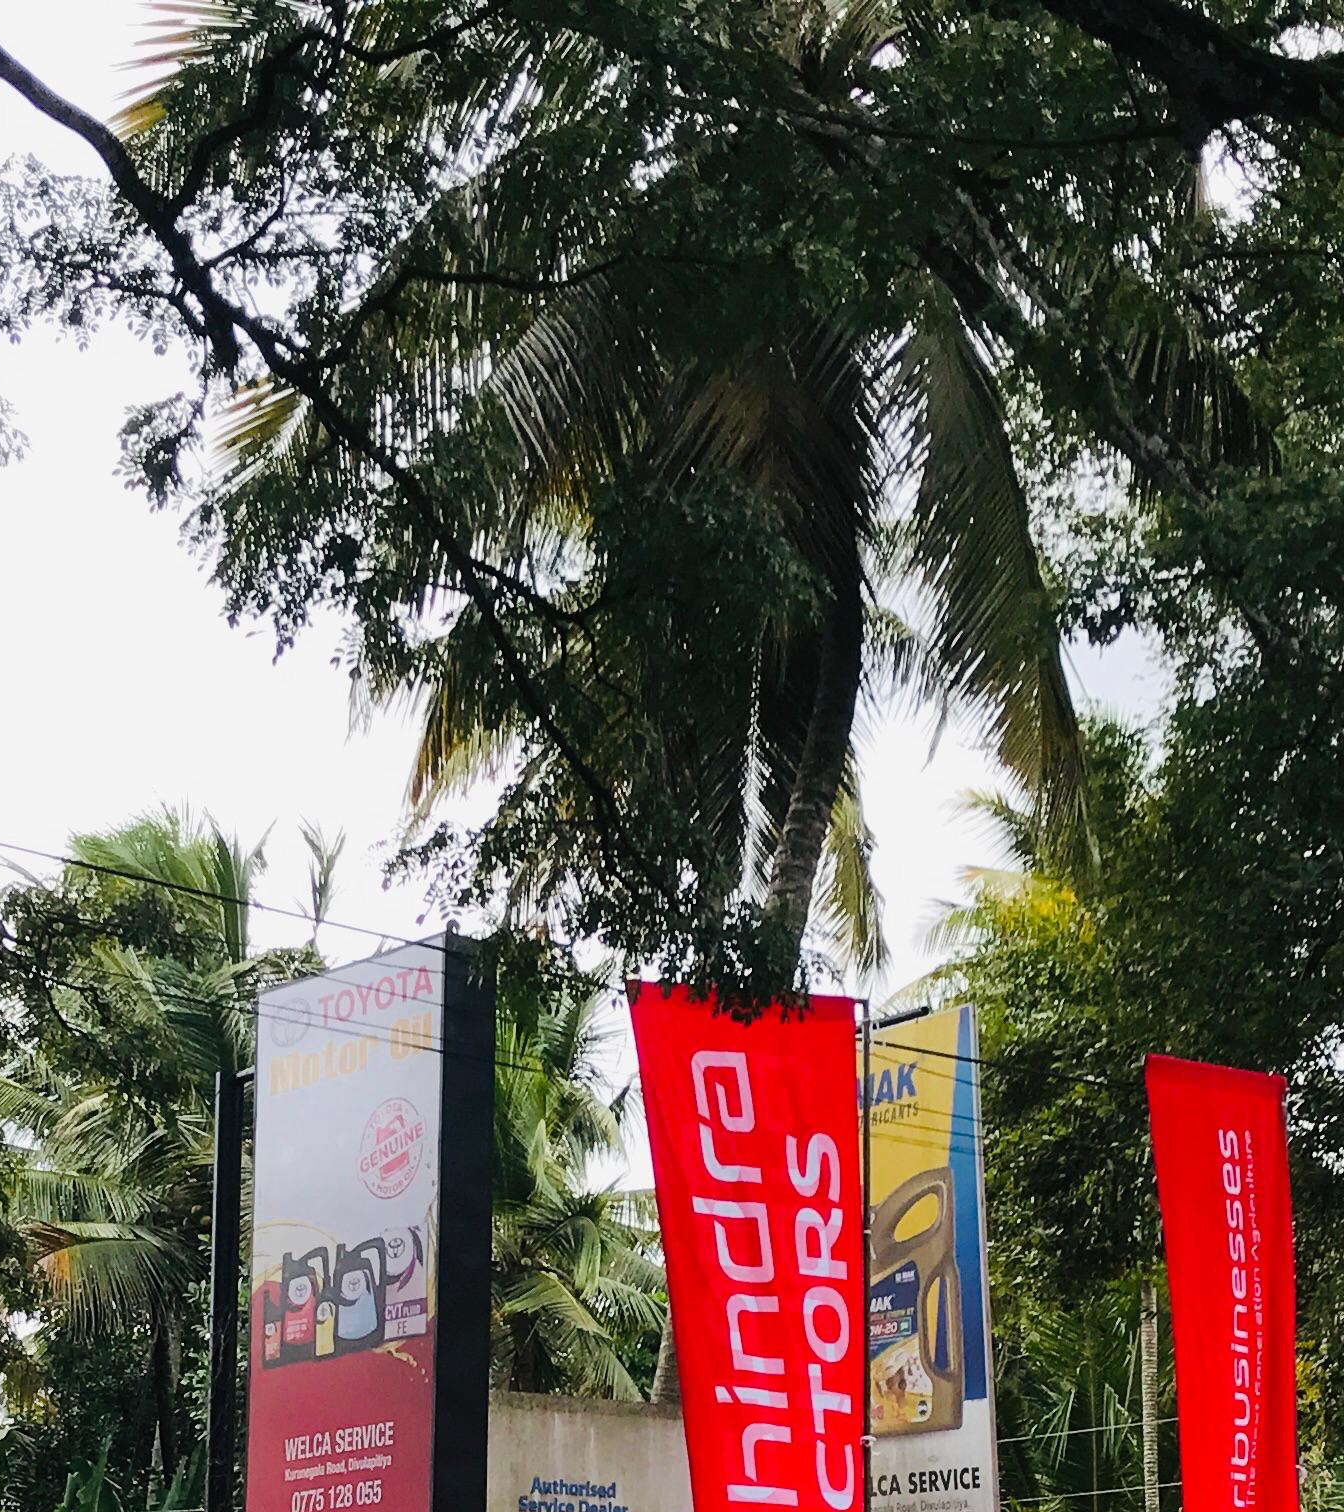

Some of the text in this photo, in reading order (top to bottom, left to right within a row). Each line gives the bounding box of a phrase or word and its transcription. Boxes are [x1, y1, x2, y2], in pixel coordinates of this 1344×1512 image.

[319, 965, 434, 1027] TOYOTA
[270, 1010, 433, 1096] Motor Oil
[360, 1121, 424, 1173] GENUINE
[385, 1303, 404, 1320] CVT
[285, 1421, 394, 1461] WELCA SERVICE
[328, 1483, 353, 1509] 128
[356, 1479, 382, 1506] 055
[529, 1476, 617, 1499] Authorised
[869, 1466, 981, 1497] LCA SERVICE
